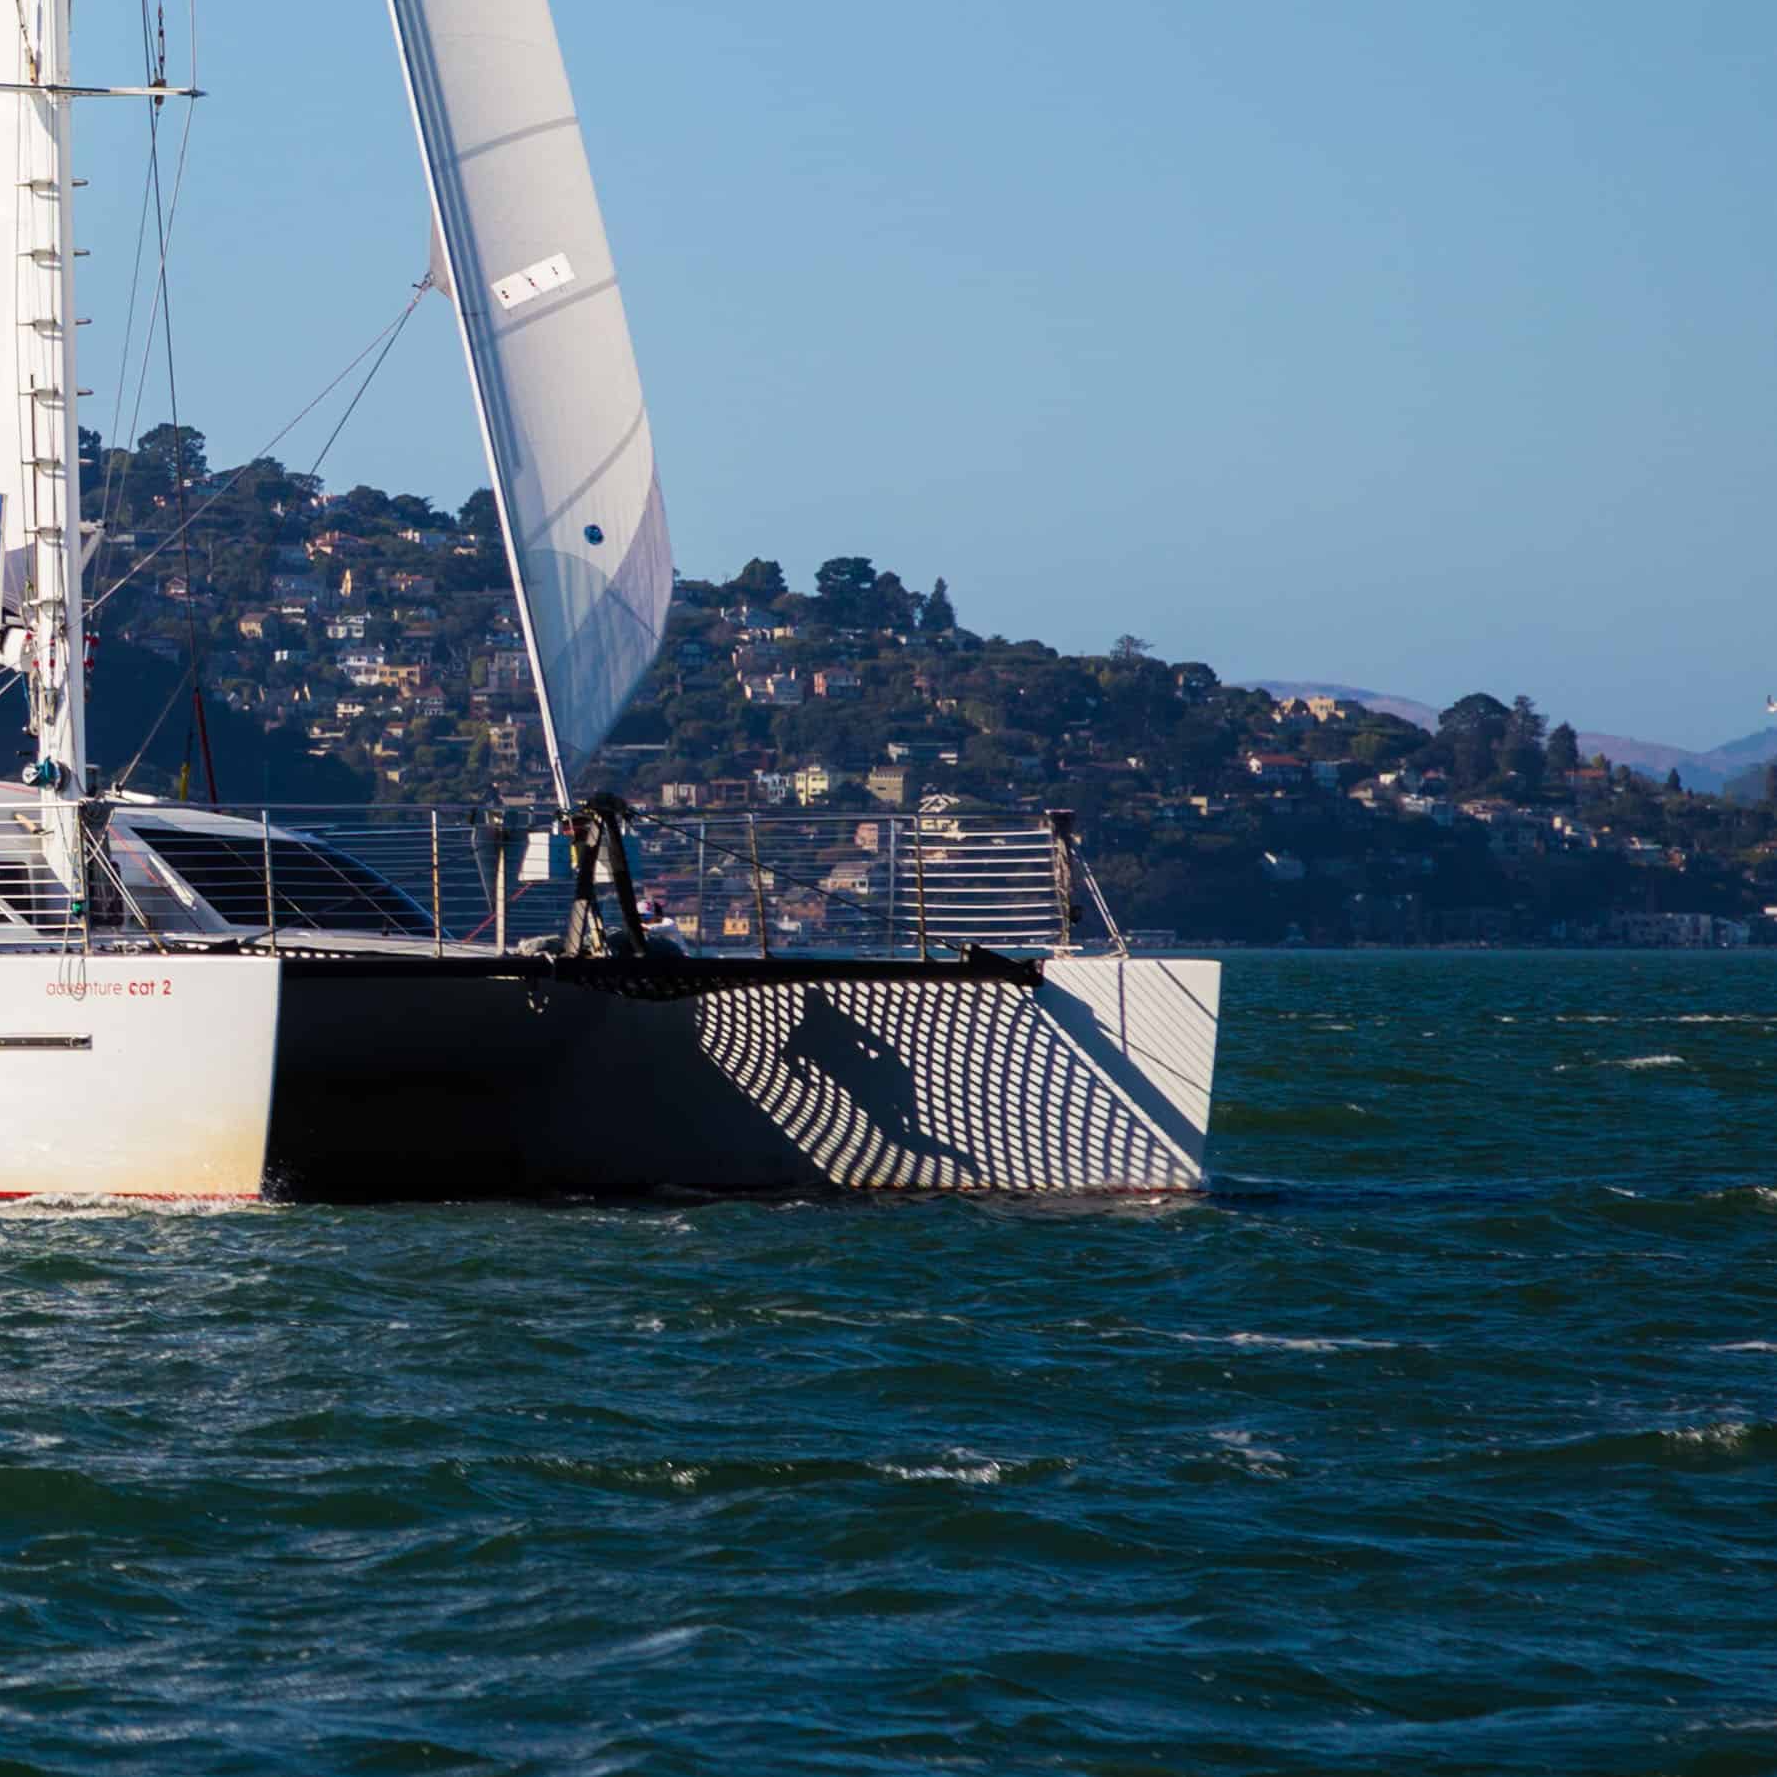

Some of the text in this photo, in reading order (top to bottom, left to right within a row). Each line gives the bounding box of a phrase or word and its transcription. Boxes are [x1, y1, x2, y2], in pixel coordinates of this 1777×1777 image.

[46, 979, 172, 996] adventure cat 2
